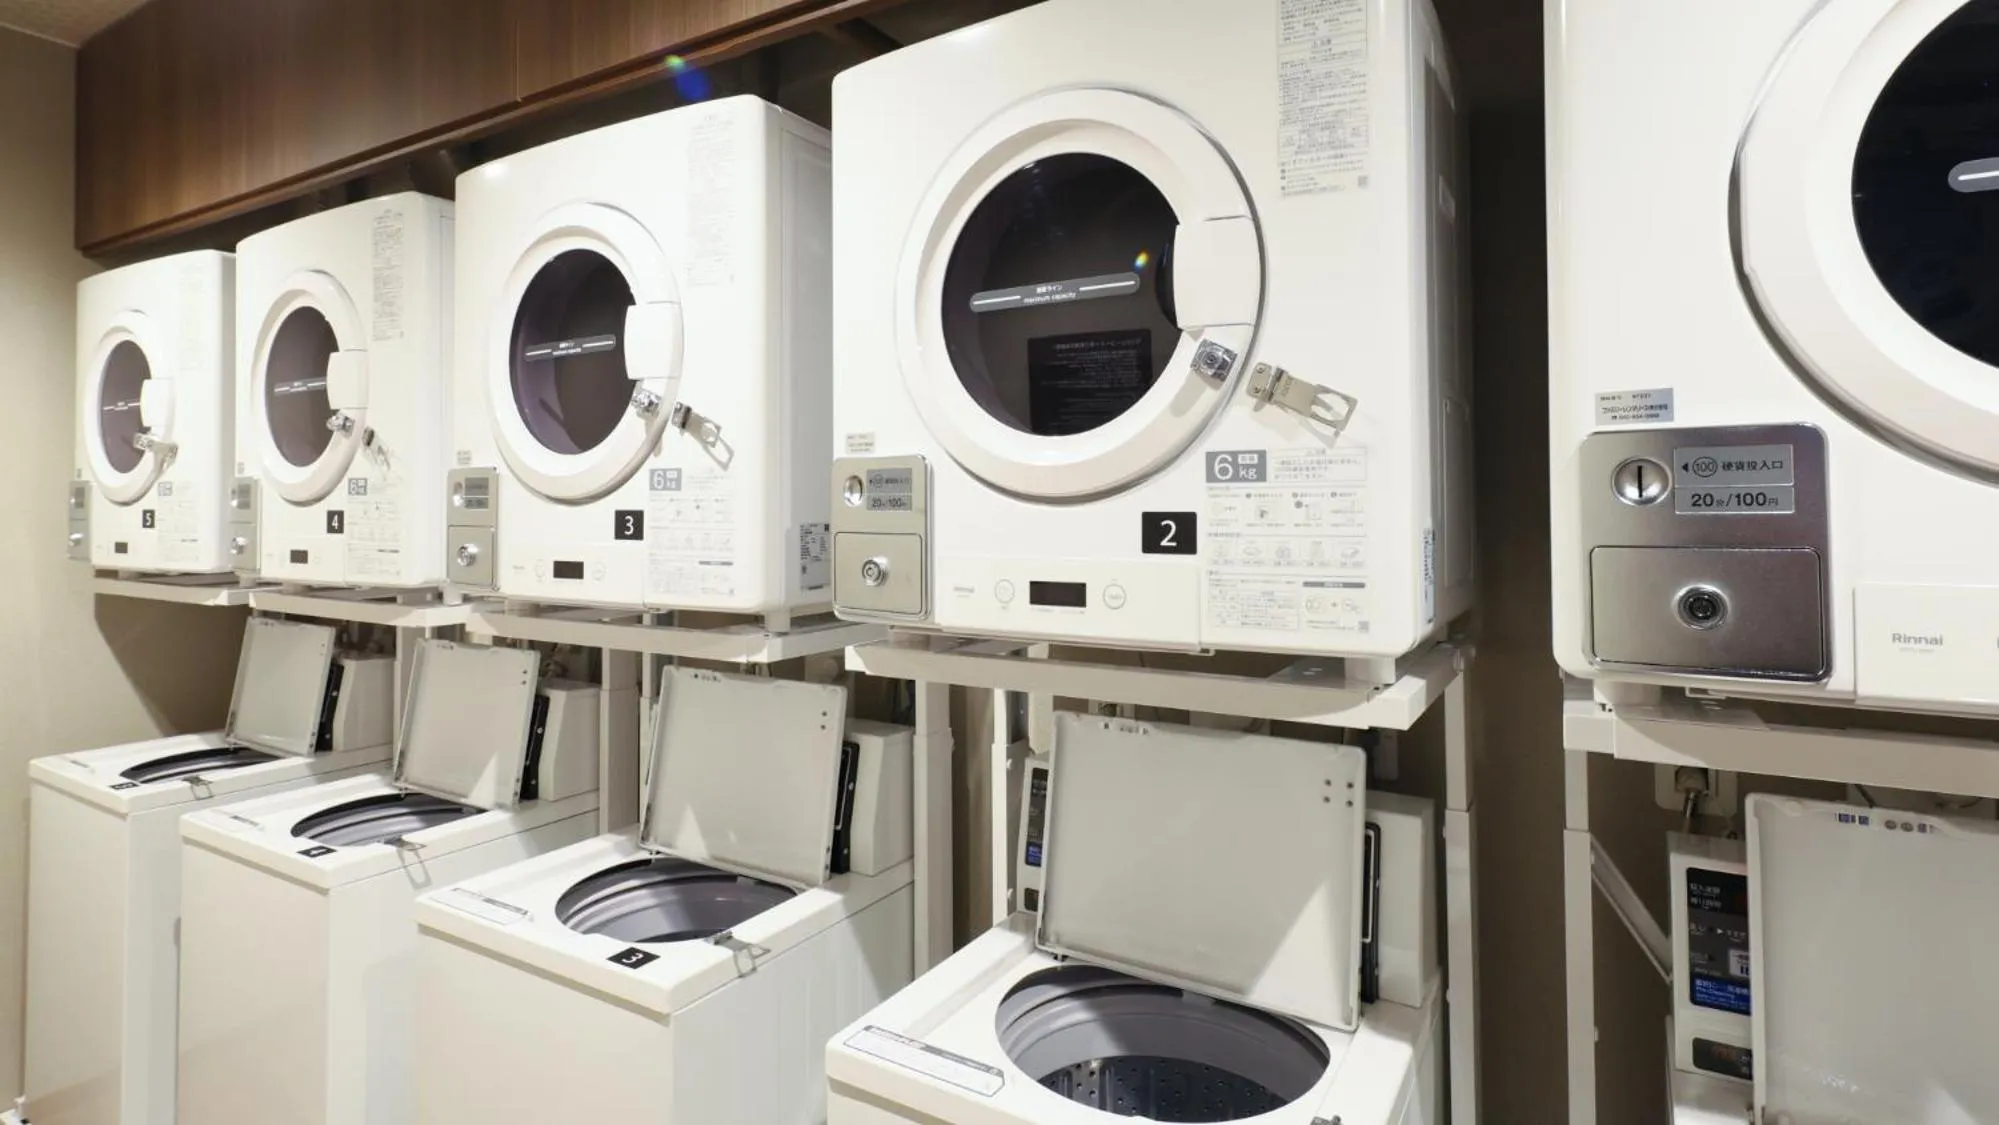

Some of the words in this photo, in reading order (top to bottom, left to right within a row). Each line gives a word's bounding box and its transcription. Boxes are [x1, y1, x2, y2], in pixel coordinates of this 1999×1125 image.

[1695, 462, 1716, 474] 100
[624, 515, 634, 535] 3
[1160, 520, 1177, 546] 2
[1891, 632, 1944, 646] Rinnai
[622, 952, 644, 963] 3
